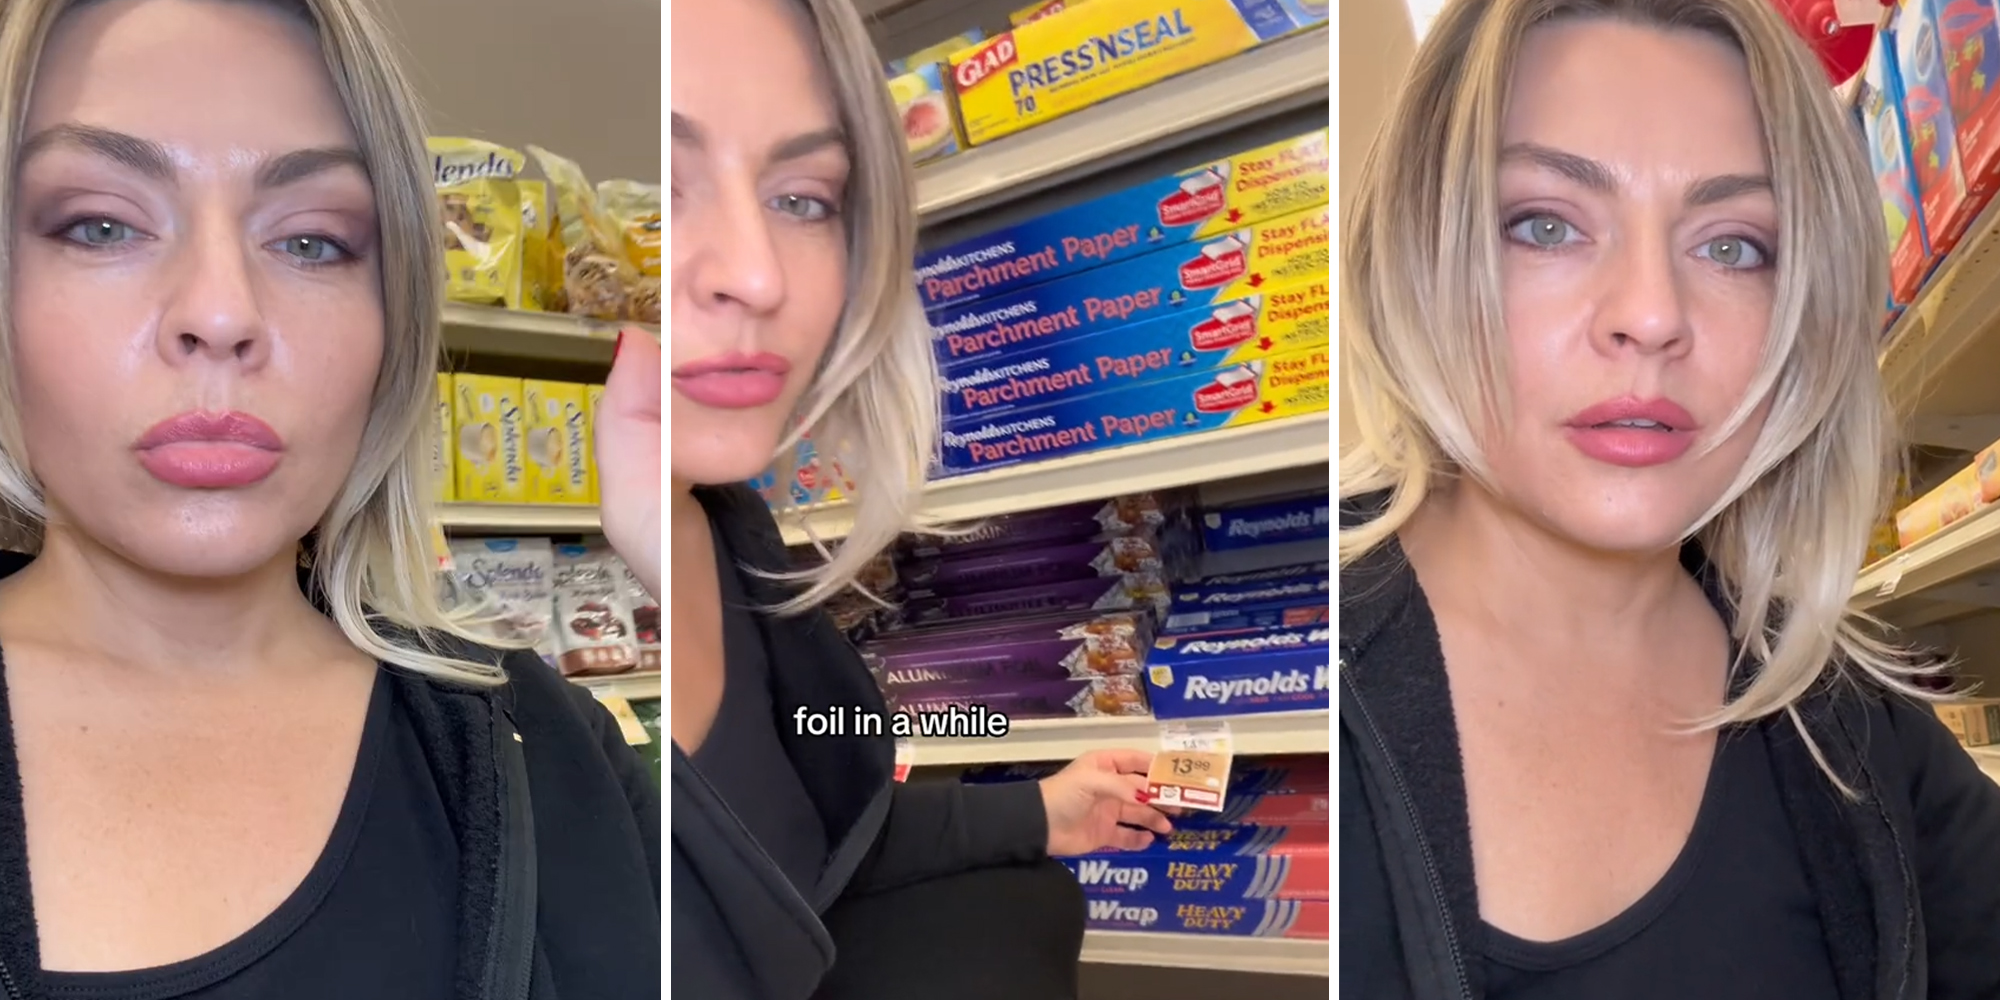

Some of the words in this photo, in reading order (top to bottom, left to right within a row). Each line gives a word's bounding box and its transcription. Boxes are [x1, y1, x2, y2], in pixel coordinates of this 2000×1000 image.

[956, 39, 1015, 88] GLAD
[1014, 95, 1036, 117] 70
[434, 151, 515, 183] lenda
[1239, 159, 1274, 176] Stay
[1261, 224, 1296, 243] Stay
[925, 246, 1059, 302] Parchment
[1061, 223, 1141, 262] Paper
[1270, 291, 1306, 308] Stay
[1310, 284, 1329, 298] FL
[946, 305, 1081, 357] Parchment
[1082, 286, 1163, 321] Paper
[1273, 360, 1308, 374] Stay
[1311, 353, 1329, 366] FL
[962, 363, 1093, 410] Parchment
[1095, 347, 1173, 378] Paper
[967, 421, 1098, 463] Parchment
[1100, 408, 1177, 437] Paper
[1183, 669, 1311, 704] Reynolds
[1078, 859, 1149, 891] Wrap
[1166, 861, 1238, 879] HEAVY
[1173, 879, 1225, 891] DUTY
[1088, 899, 1158, 926] Wrap
[1176, 904, 1246, 920] HEAVY
[1183, 918, 1233, 929] DUTY
